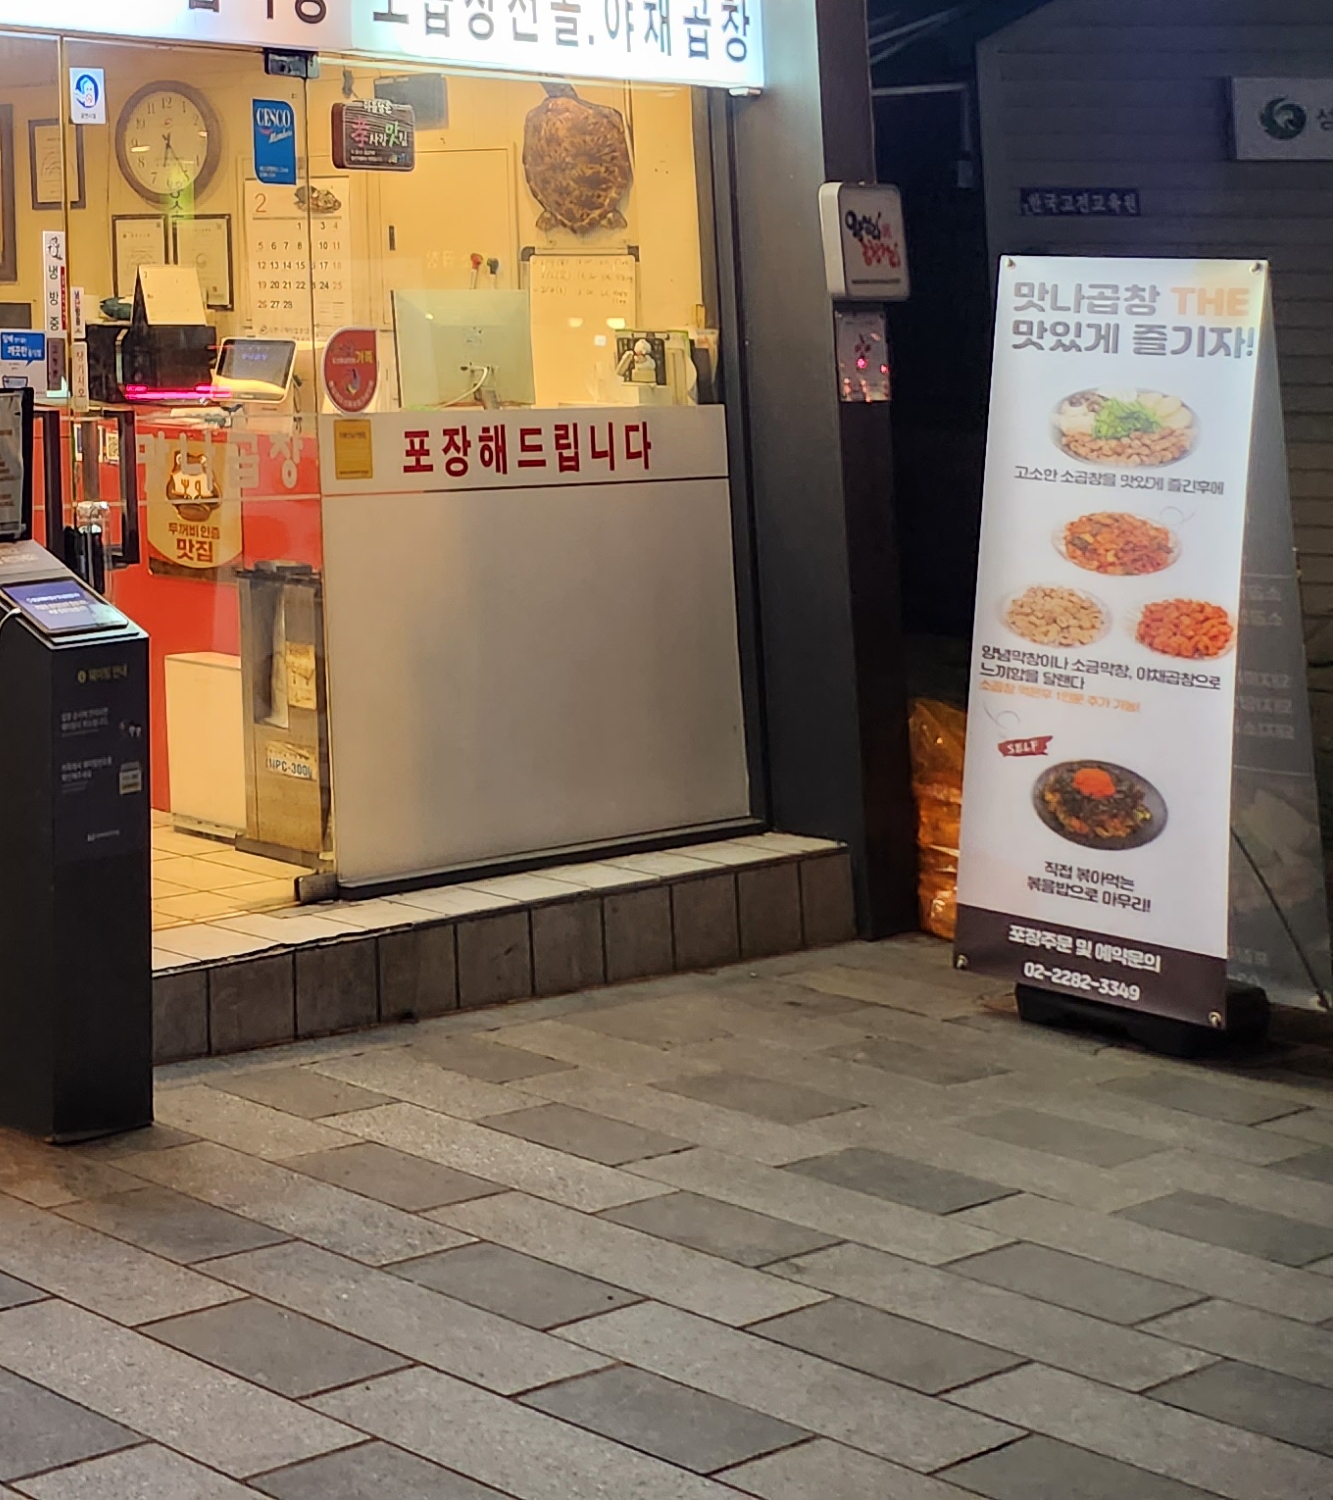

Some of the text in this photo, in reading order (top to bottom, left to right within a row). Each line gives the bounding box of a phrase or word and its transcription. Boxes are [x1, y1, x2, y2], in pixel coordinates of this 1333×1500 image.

[256, 108, 291, 127] CESCO
[254, 193, 267, 213] 2
[1013, 281, 1250, 317] 맛나곱창 THE
[1011, 320, 1255, 359] 맛있게 즐기자!
[402, 421, 652, 478] 포장해드립니다
[1060, 470, 1116, 487] 소곱창을
[1120, 474, 1164, 491] 맛있게
[177, 538, 213, 563] 맛집
[980, 662, 1085, 690] 느끼함을 달랜다
[981, 645, 1222, 690] 양념막창이나 소금막창, 야채곱창으로
[1006, 740, 1038, 754] SELF
[1044, 861, 1073, 880] 직접
[1027, 876, 1099, 903] 볶음밥으로
[1008, 924, 1162, 974] 포장주문 및 예약문의
[1023, 962, 1141, 1001] 02-2282-3349
